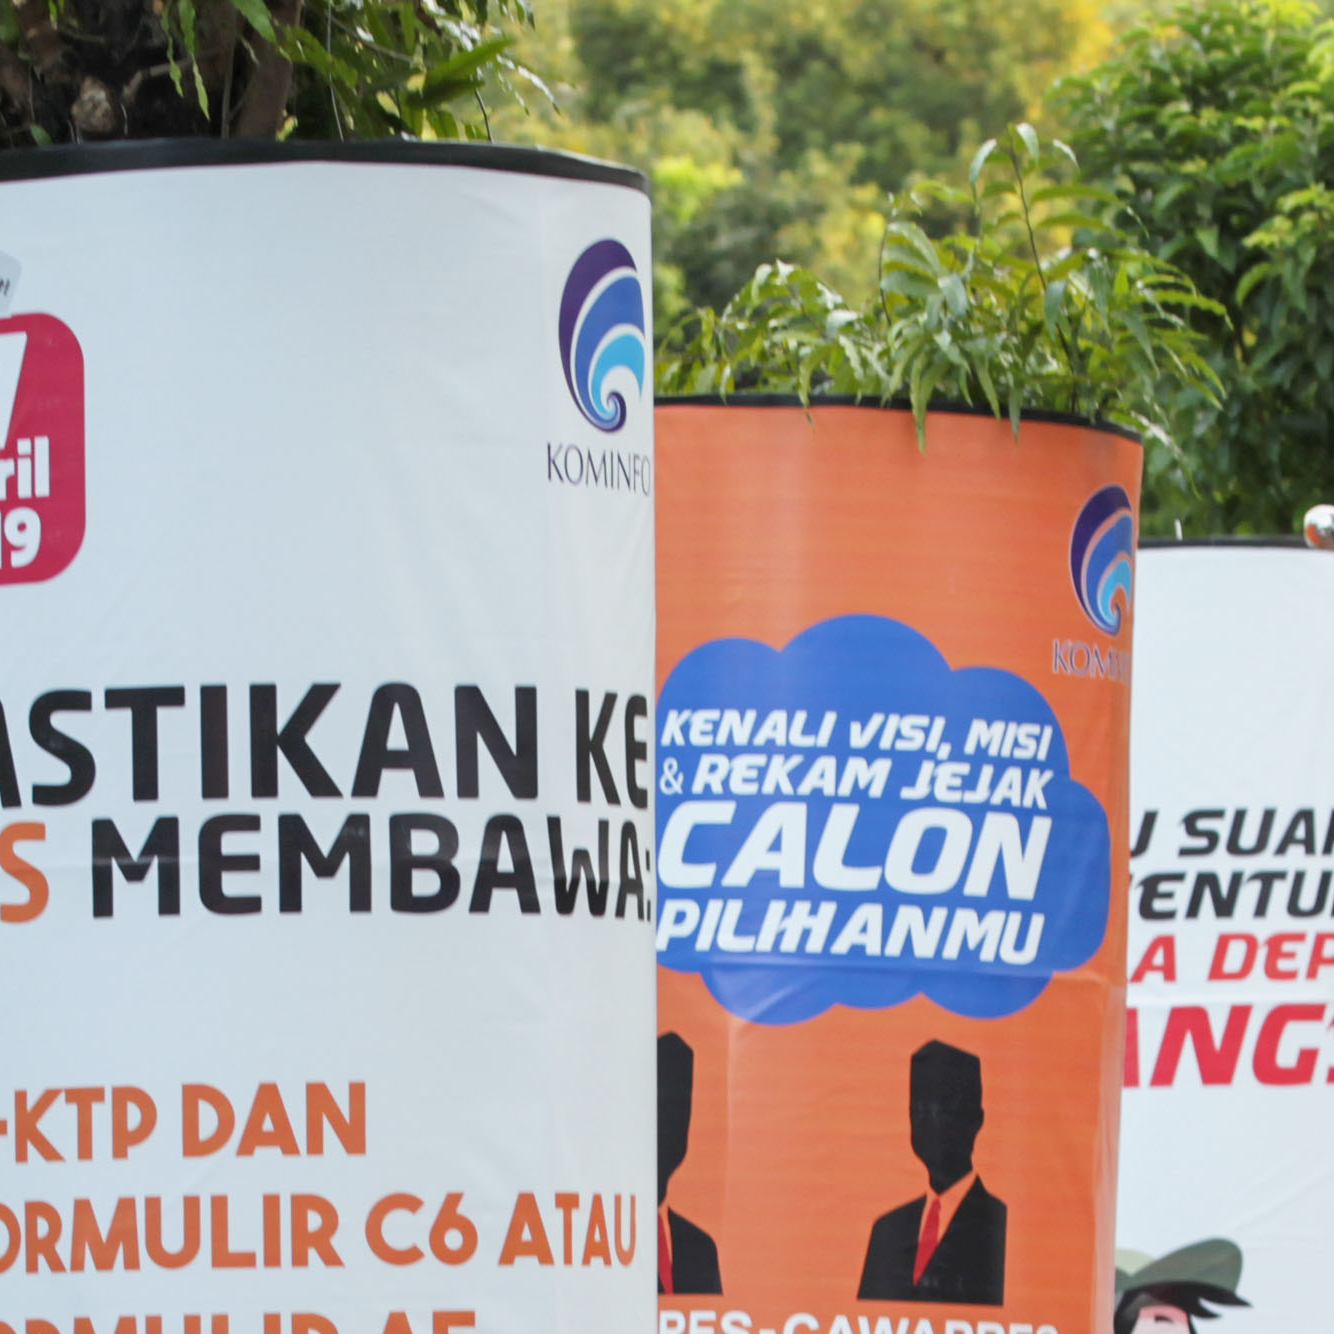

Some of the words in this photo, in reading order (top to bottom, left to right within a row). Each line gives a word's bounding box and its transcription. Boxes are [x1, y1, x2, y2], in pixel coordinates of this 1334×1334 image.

[547, 441, 652, 497] KOMINFO
[575, 689, 649, 810] KE
[661, 709, 837, 747] KENALI
[849, 713, 951, 760] VISI,
[964, 718, 1054, 761] MISI
[659, 756, 684, 796] &
[692, 754, 893, 800] REKAM
[900, 761, 1054, 810] JEJAK
[91, 813, 651, 922] MEMBAWA
[657, 800, 1053, 901] CALON
[655, 898, 1045, 965] PILIHANMU
[181, 1081, 367, 1158] DAN
[364, 1193, 479, 1267] C6
[498, 1192, 637, 1268] ATAU
